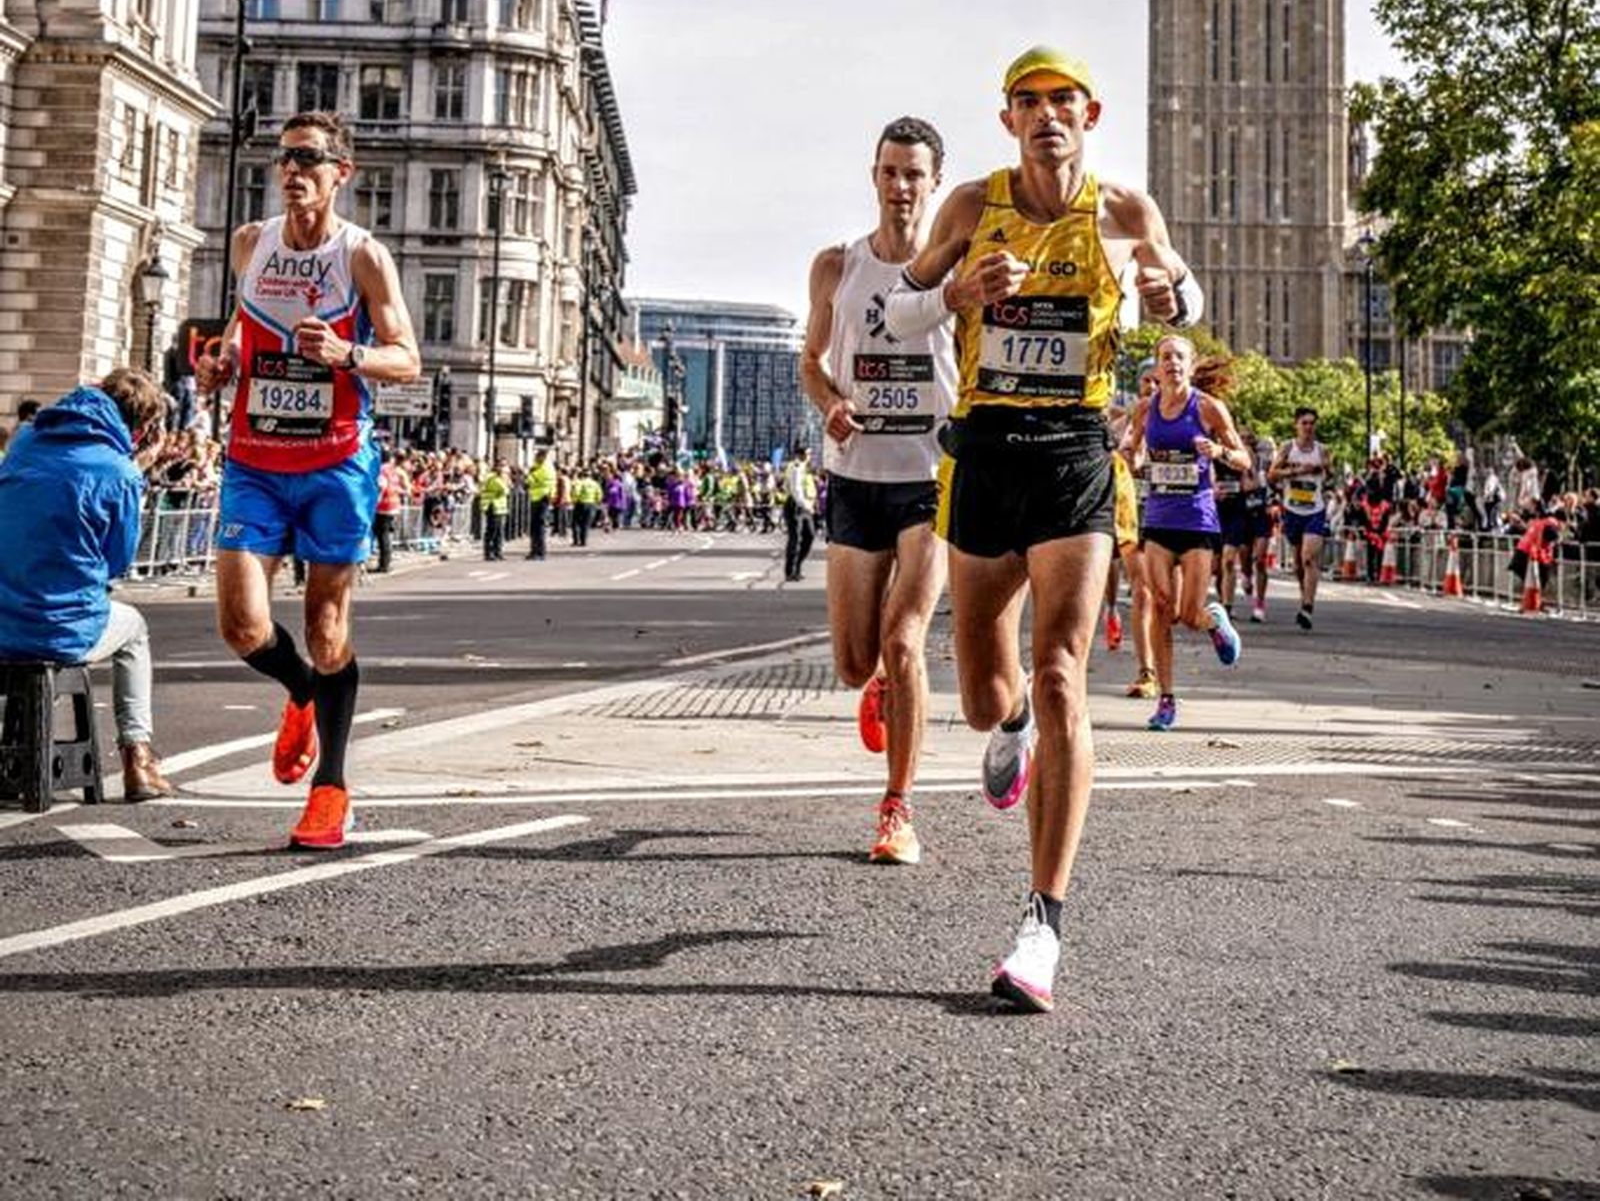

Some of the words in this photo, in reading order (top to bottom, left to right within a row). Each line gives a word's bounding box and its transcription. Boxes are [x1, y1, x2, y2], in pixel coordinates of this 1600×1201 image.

[262, 251, 332, 284] Andy
[1002, 336, 1067, 365] 1779
[260, 386, 321, 411] 19284
[868, 387, 918, 409] 2505
